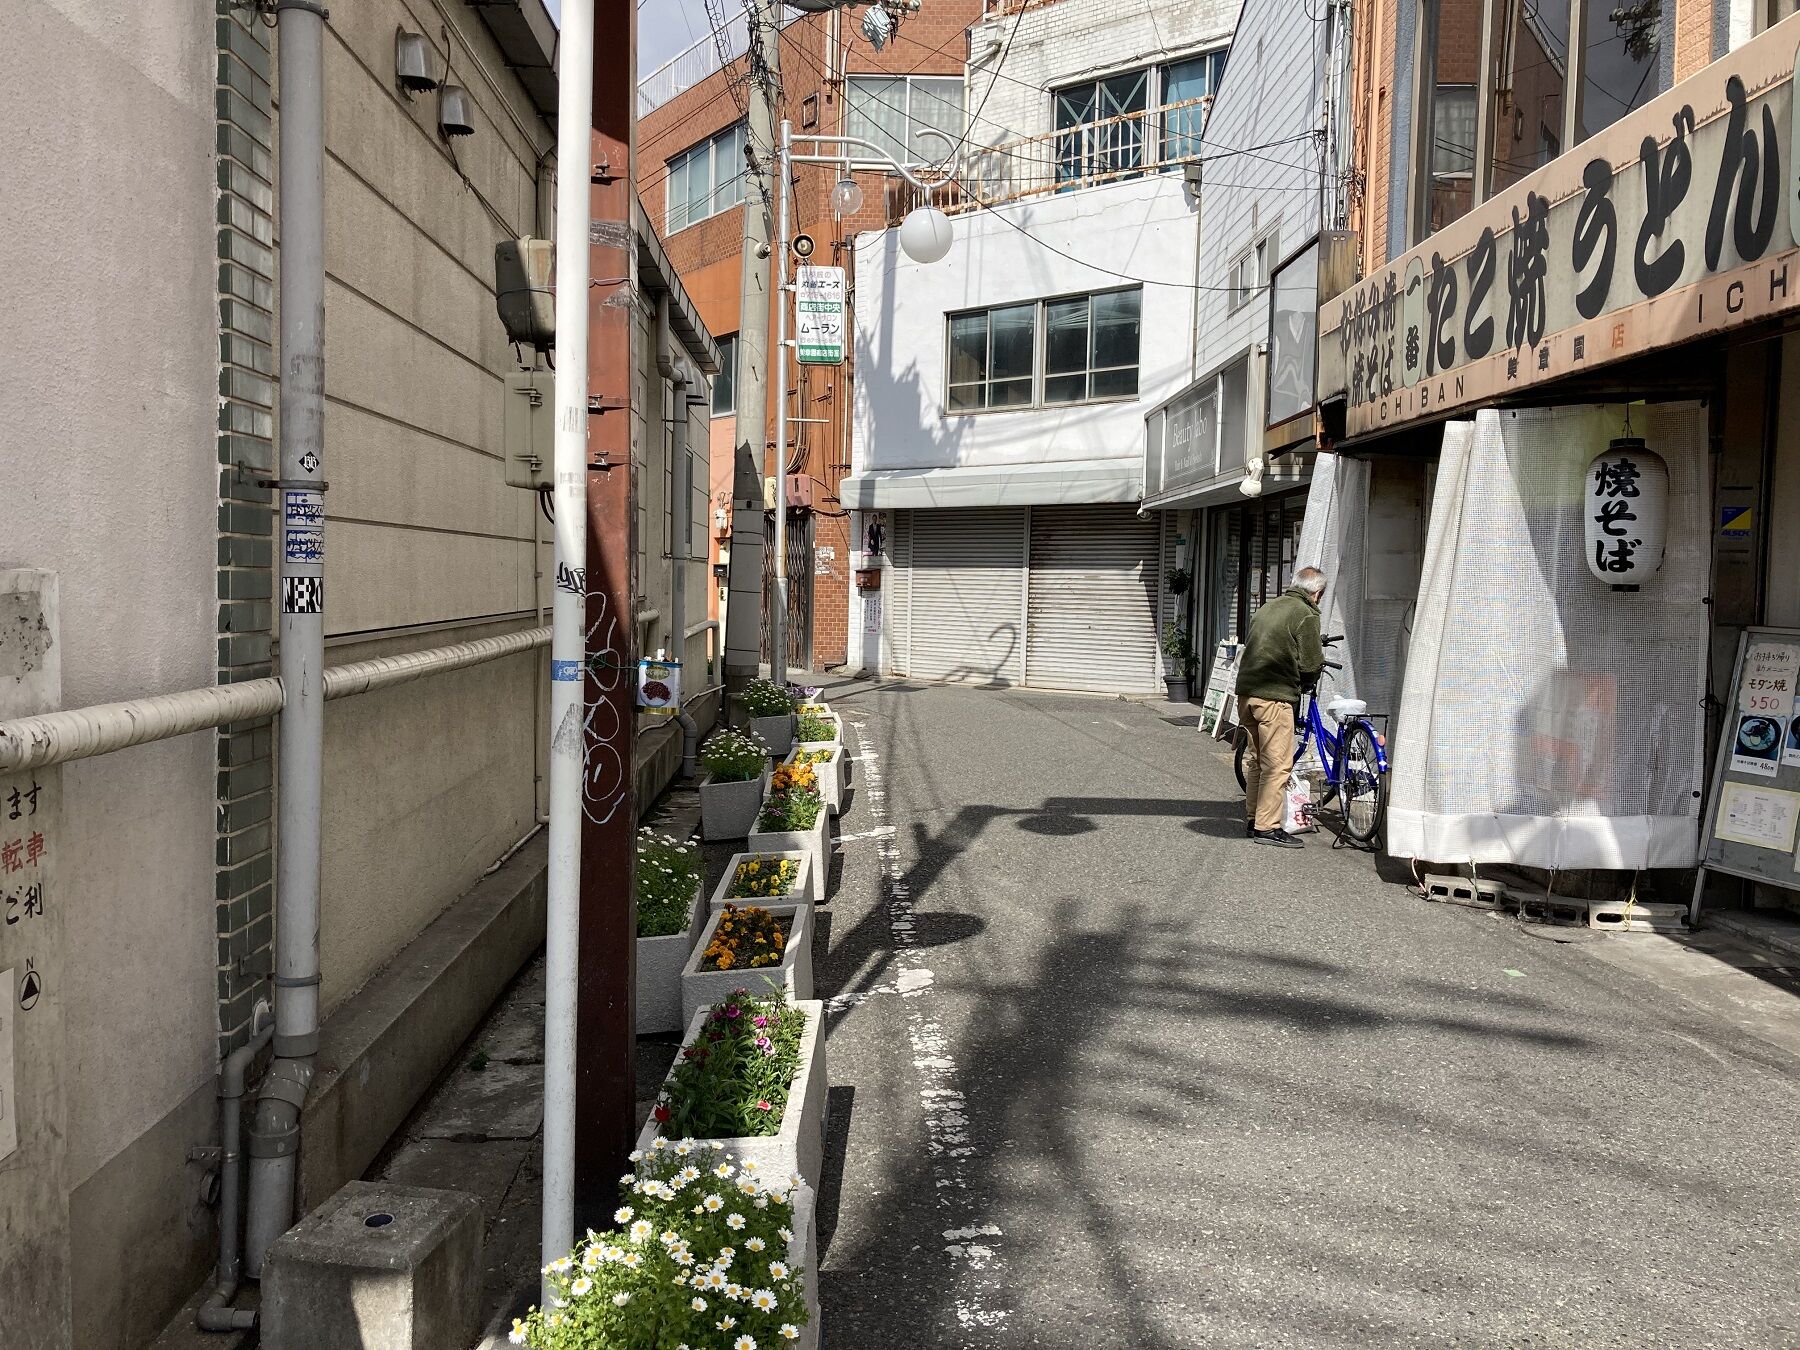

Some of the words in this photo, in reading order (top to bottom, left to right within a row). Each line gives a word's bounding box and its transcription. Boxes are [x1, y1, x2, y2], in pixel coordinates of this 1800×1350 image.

[800, 302, 841, 313] 商店街中央
[801, 323, 840, 334] ムーラン
[1370, 374, 1464, 424] ICHIBAN
[1594, 457, 1643, 573] 焼そば
[1748, 678, 1788, 692] モダン焼
[0, 780, 43, 820] ます
[26, 957, 34, 971] N
